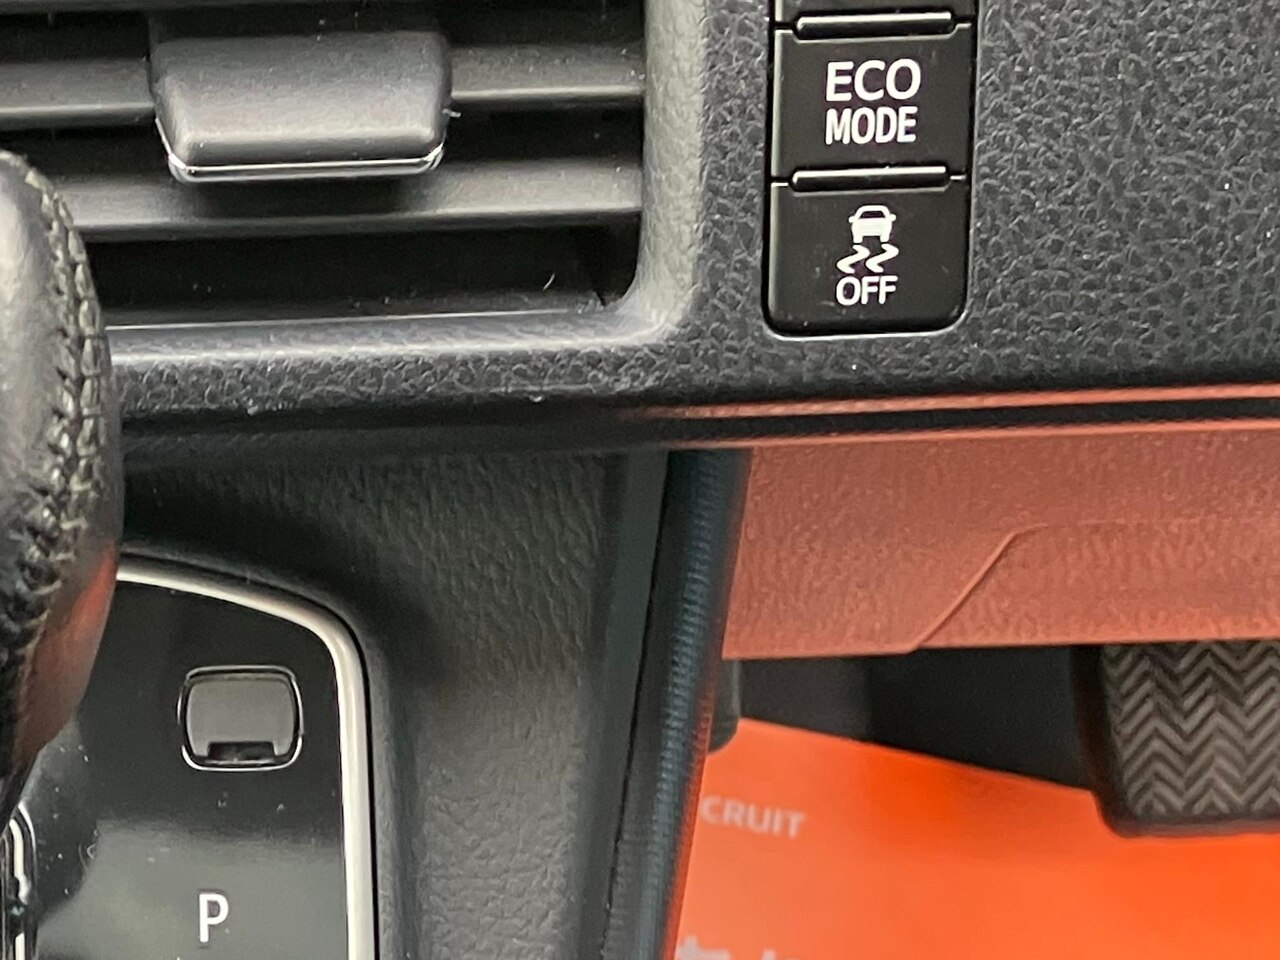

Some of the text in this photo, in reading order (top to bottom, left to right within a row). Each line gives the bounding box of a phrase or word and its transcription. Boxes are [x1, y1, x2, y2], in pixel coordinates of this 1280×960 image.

[825, 58, 921, 102] ECO
[825, 105, 918, 145] MODE
[835, 275, 898, 306] OFF
[199, 892, 229, 943] P
